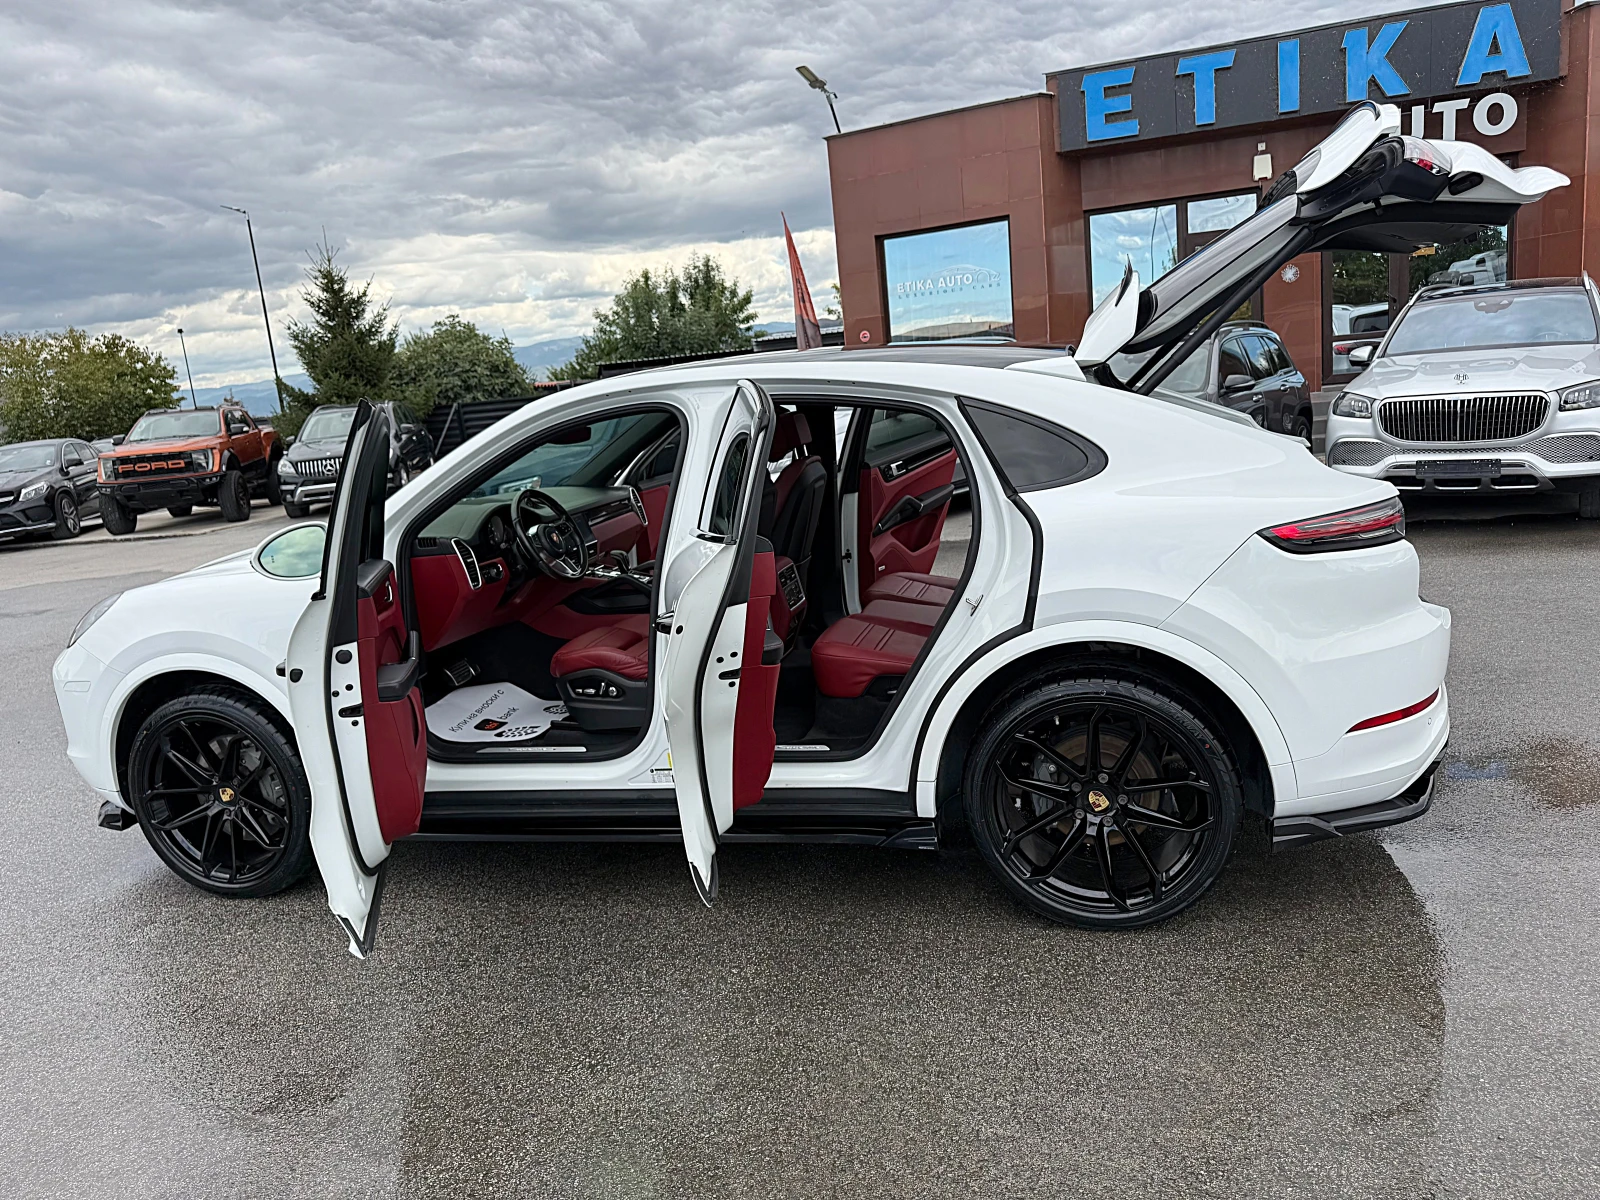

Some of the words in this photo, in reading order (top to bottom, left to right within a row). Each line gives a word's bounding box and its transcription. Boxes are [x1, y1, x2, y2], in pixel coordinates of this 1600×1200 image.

[1081, 3, 1531, 141] ETIKA
[1389, 93, 1518, 141] UTO
[897, 278, 934, 293] ETIKA
[938, 273, 973, 289] AUTO
[898, 287, 964, 299] LUXURIOUS
[118, 459, 186, 474] FORD
[449, 719, 469, 733] Купи
[467, 712, 478, 721] на
[475, 694, 500, 715] вноски
[496, 706, 520, 720] bank
